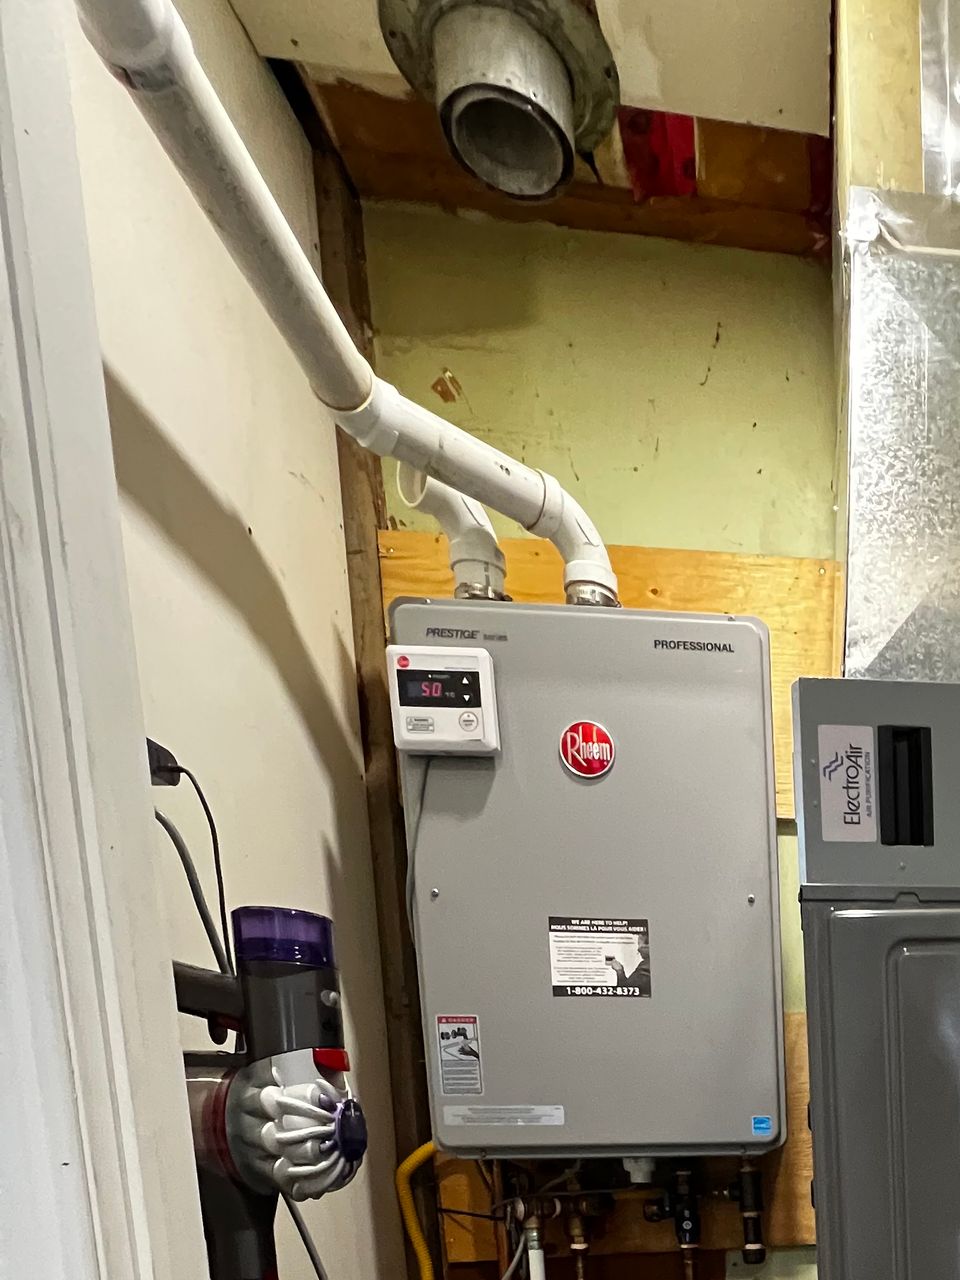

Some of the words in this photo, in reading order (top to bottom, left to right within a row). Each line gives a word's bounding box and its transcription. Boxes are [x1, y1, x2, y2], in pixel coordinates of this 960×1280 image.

[425, 627, 480, 640] PRESTIGE
[653, 639, 735, 653] PROFESSIONAL
[421, 682, 442, 697] 50
[566, 725, 610, 767] Rheem
[842, 743, 863, 825] ElectroAir
[566, 986, 640, 996] 1-800-432-8373
